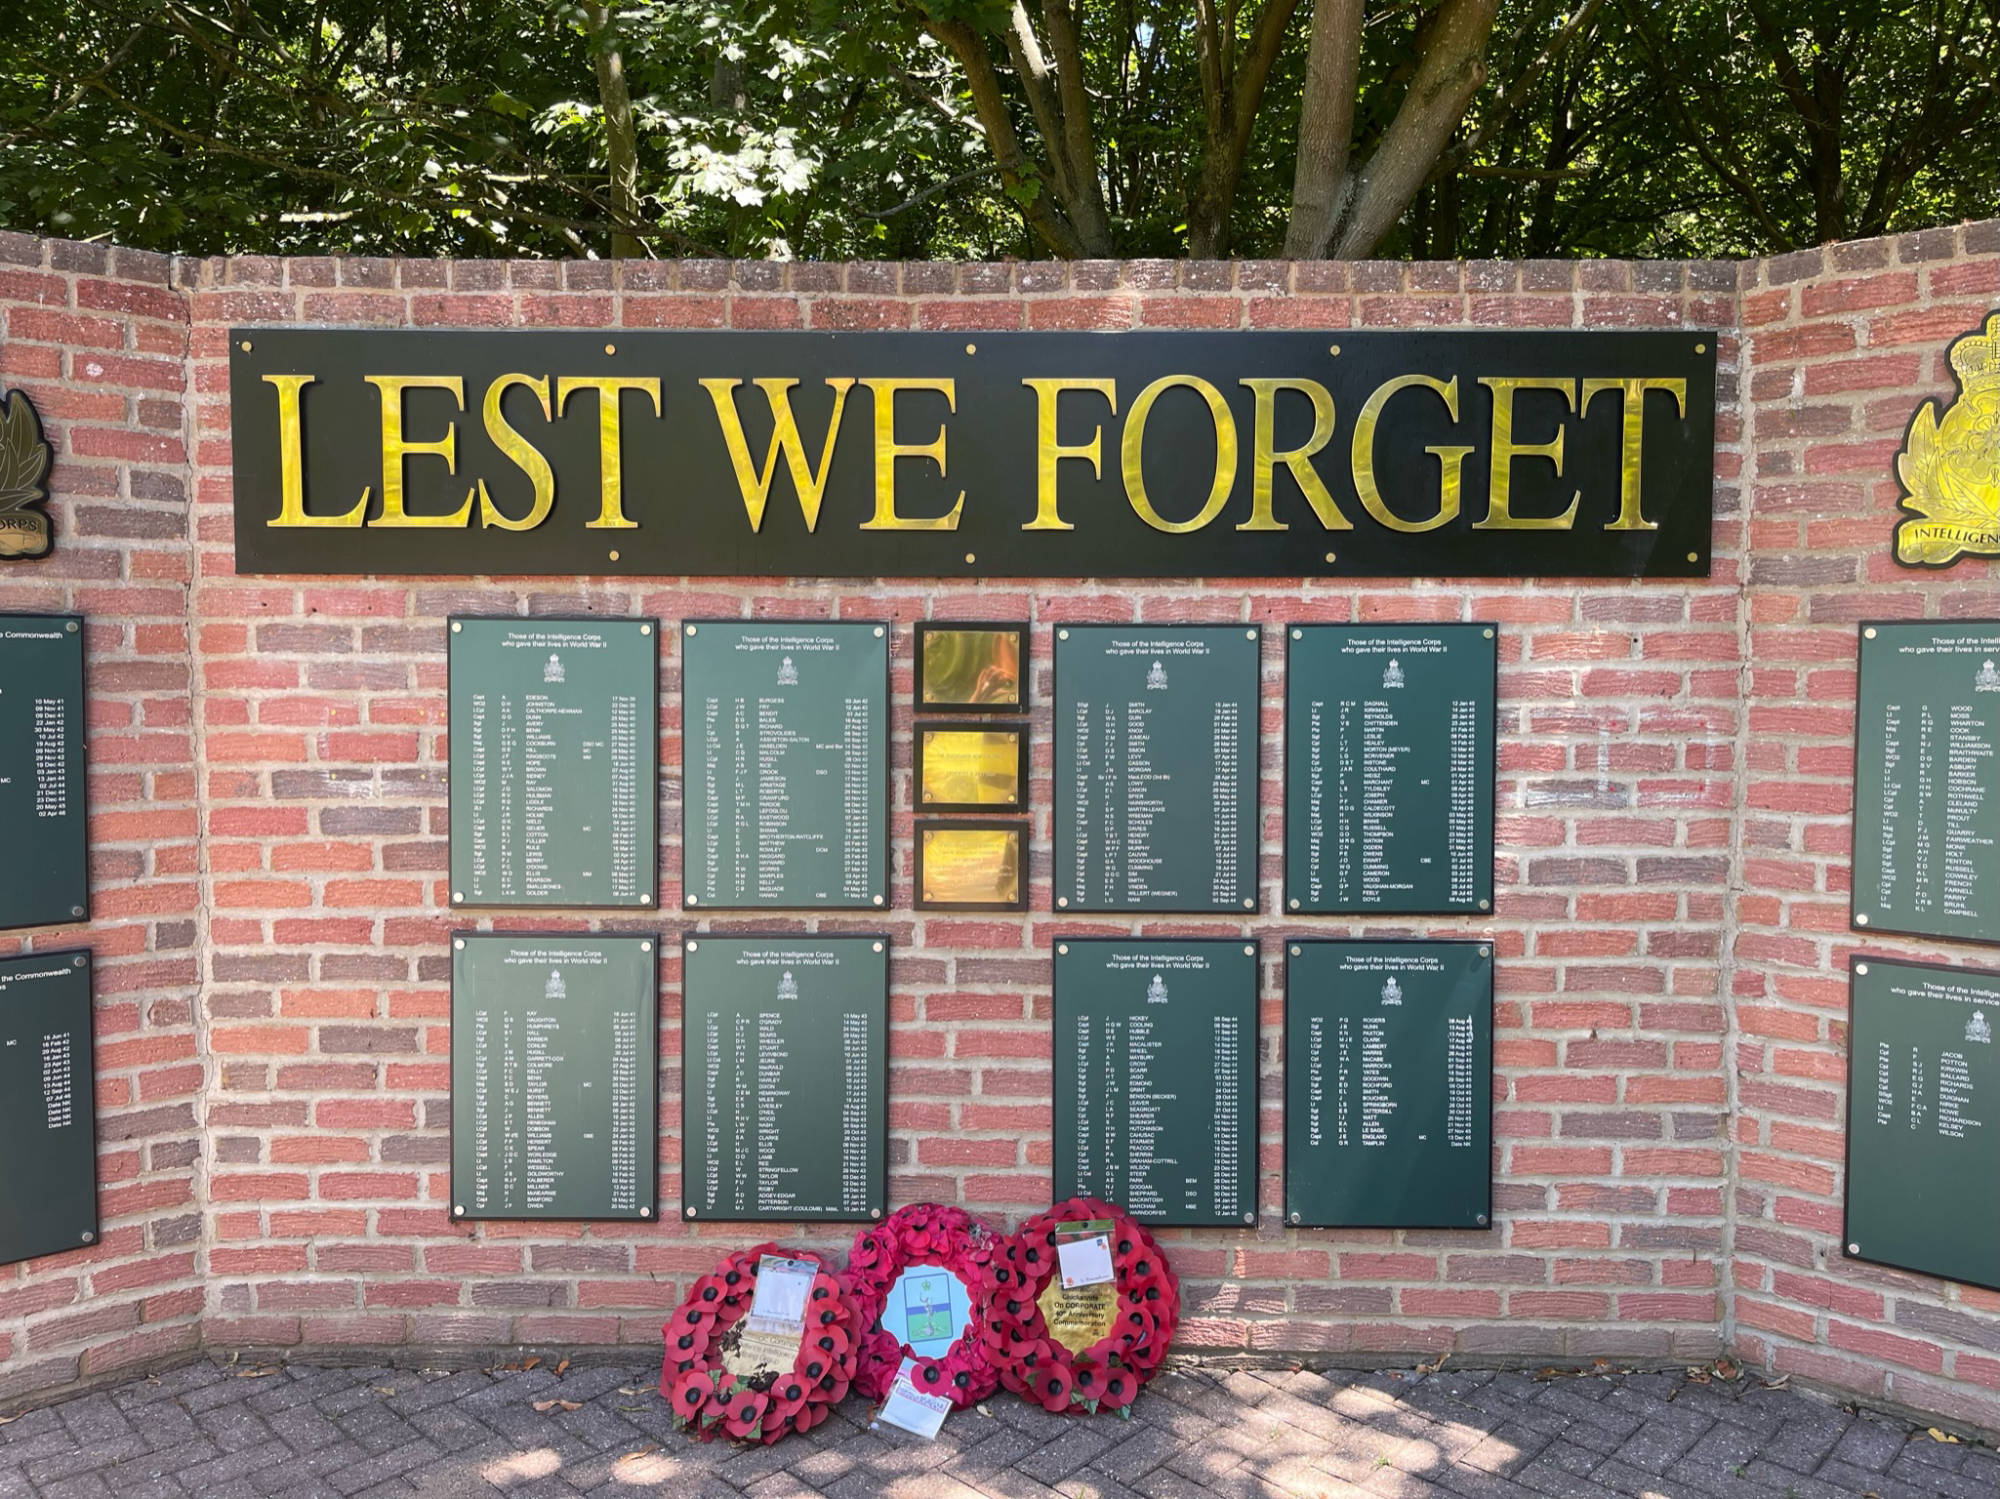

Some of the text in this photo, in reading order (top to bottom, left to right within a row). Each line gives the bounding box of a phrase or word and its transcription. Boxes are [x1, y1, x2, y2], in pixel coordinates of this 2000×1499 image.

[261, 373, 1687, 534] LEST WE FORGET
[1915, 528, 2000, 544] INTELLIGEN
[15, 968, 72, 980] Commonwealth
[1923, 982, 1945, 991] Those
[1957, 986, 1968, 994] the
[1946, 993, 1962, 1002] lives
[1973, 998, 2000, 1006] service
